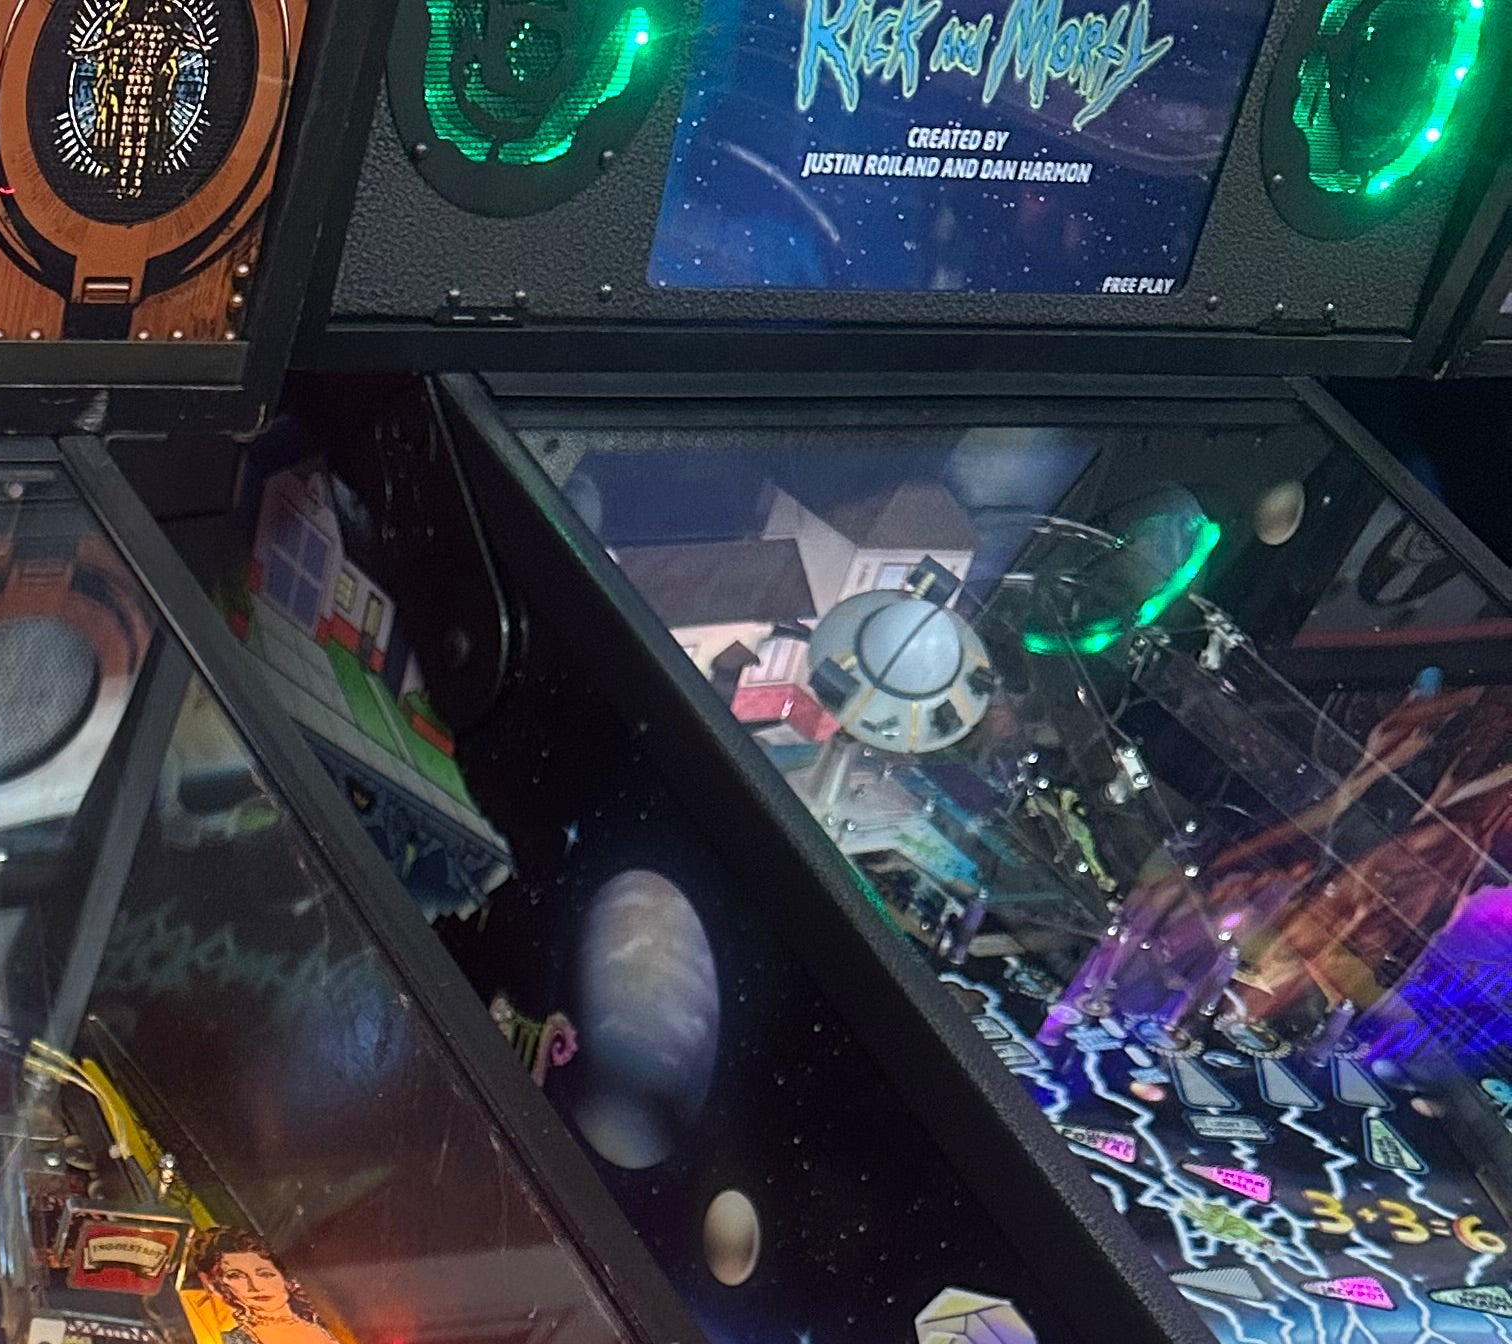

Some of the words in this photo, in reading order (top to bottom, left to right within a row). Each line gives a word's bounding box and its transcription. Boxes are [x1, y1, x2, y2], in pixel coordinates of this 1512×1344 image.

[908, 127, 981, 151] CREATED
[983, 130, 1010, 152] BY
[801, 153, 868, 178] JUSTIN
[864, 158, 937, 179] ROILAND
[940, 161, 977, 180] AND
[980, 162, 1016, 181] DAN
[1018, 163, 1092, 183] HARMON
[1102, 276, 1138, 293] FREE
[1139, 278, 1175, 295] PLAY
